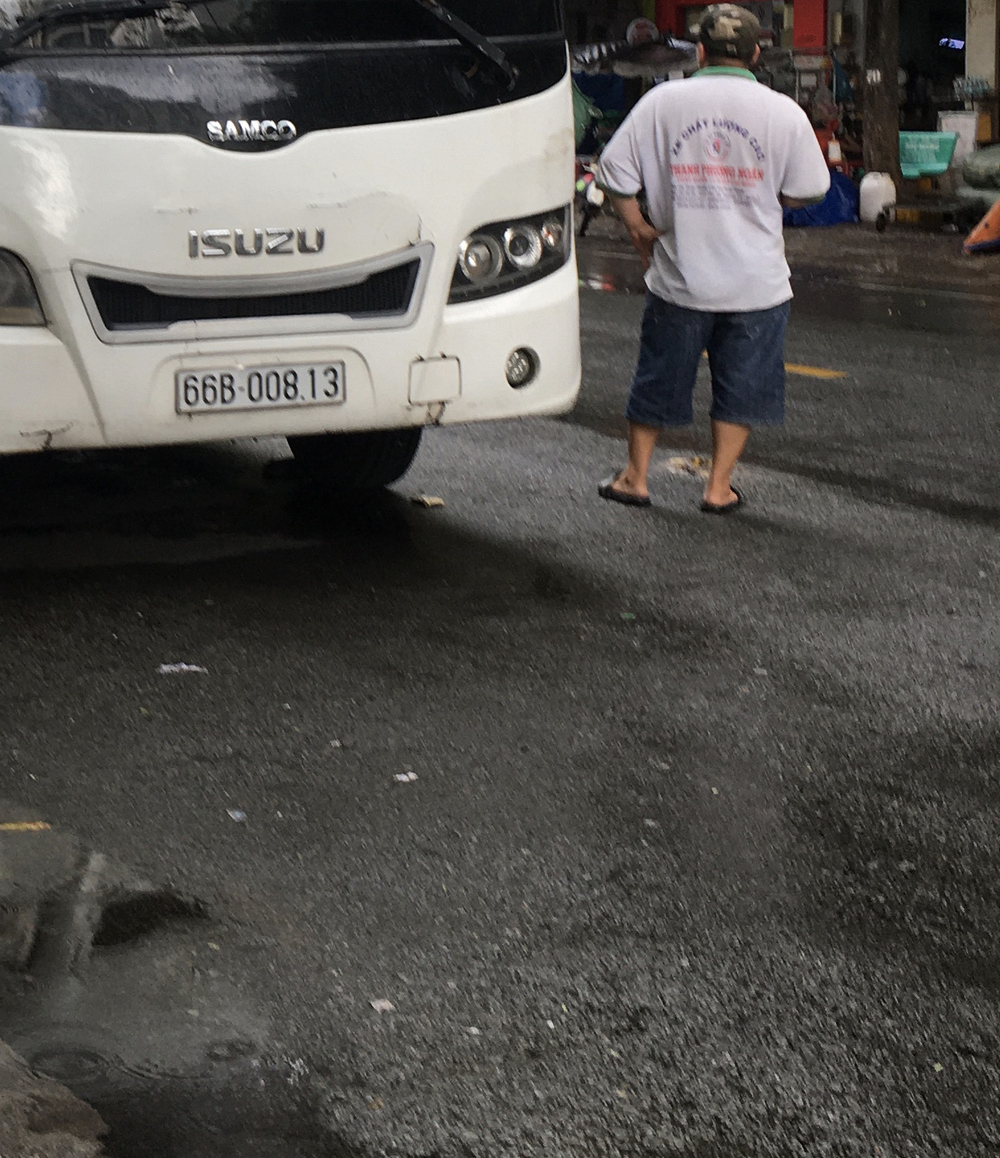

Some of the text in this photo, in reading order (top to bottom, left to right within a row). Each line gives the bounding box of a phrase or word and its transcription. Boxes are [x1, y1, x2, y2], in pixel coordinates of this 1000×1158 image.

[205, 119, 298, 142] SAMCO
[187, 226, 326, 259] ISUZU
[183, 366, 340, 407] 66B-008.13
